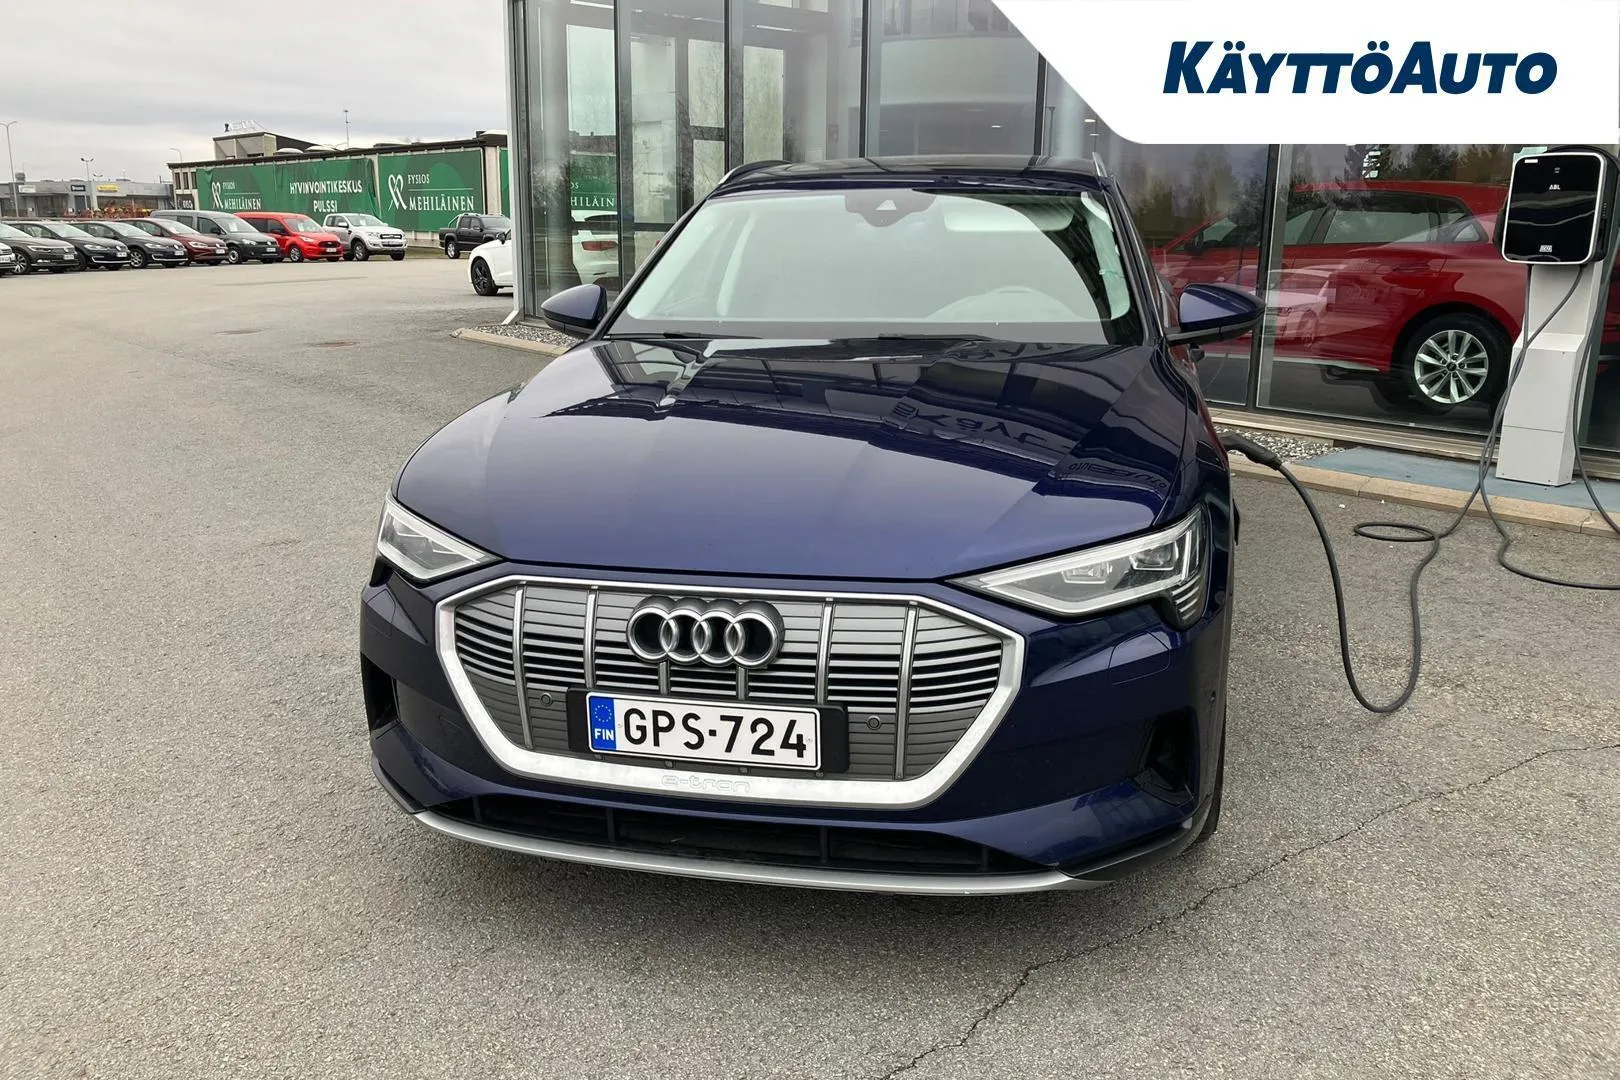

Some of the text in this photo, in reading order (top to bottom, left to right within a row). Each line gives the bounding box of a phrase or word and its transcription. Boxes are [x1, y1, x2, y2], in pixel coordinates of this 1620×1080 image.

[407, 173, 430, 185] FYSIOS
[289, 179, 363, 196] HYVINVOINTIKESKUS
[224, 196, 262, 210] MEHILÄINEN
[313, 199, 338, 213] PULSSI
[408, 193, 475, 212] MEHILÄINEN
[594, 728, 614, 741] FIN
[623, 707, 807, 759] GPS-724
[661, 774, 751, 794] e-tron
